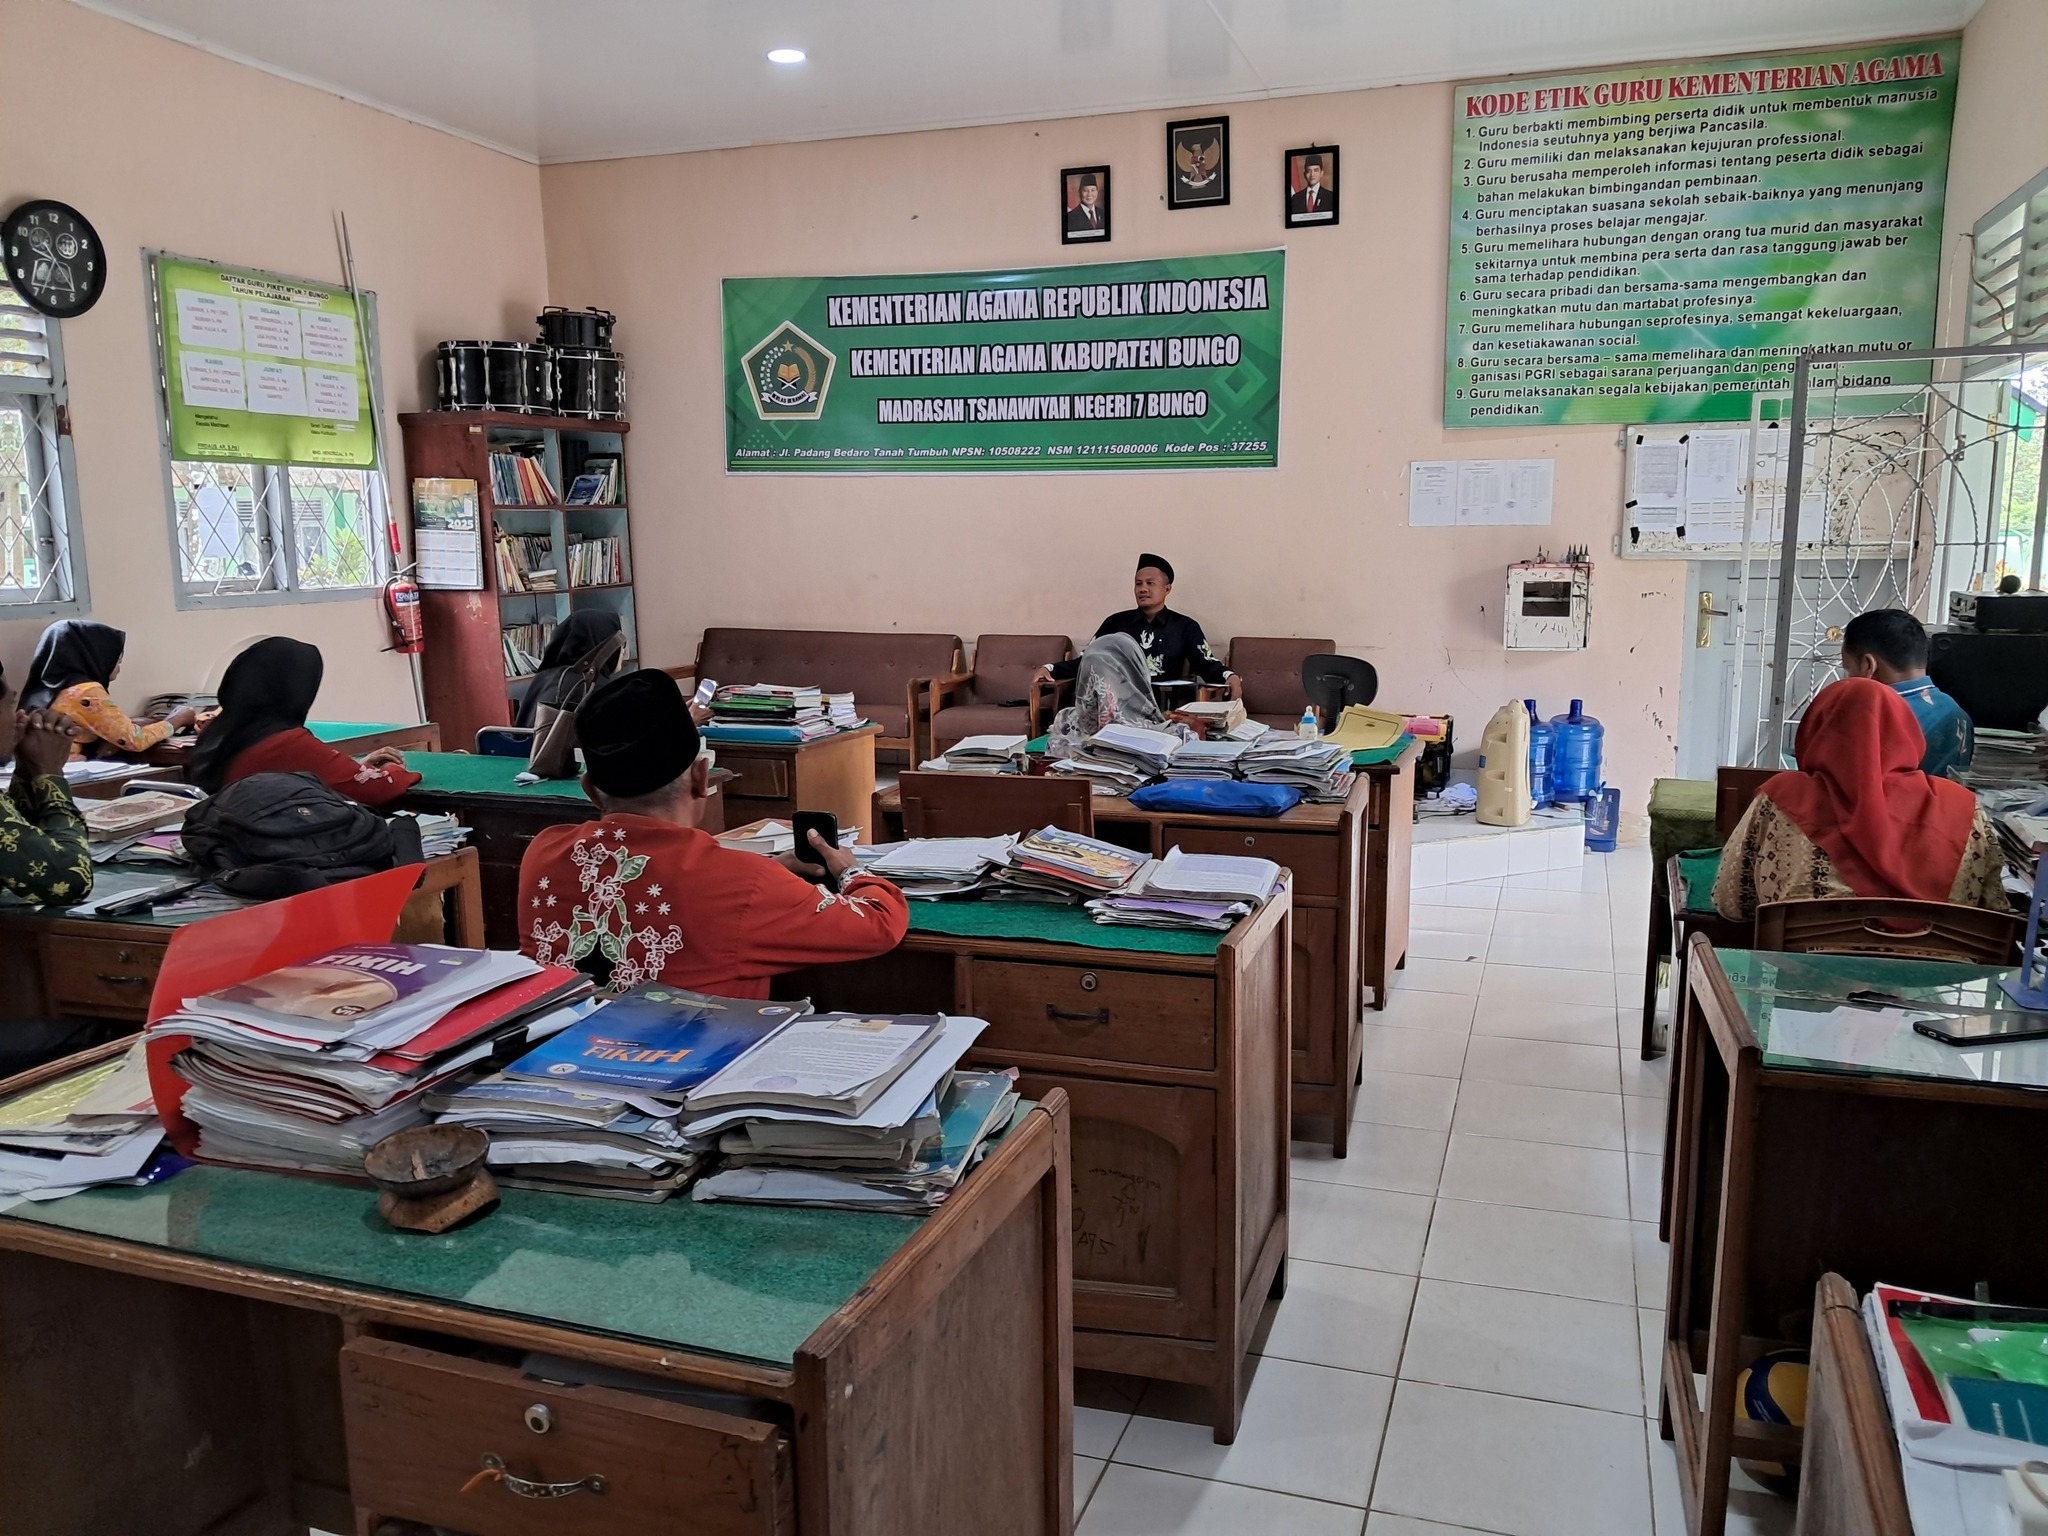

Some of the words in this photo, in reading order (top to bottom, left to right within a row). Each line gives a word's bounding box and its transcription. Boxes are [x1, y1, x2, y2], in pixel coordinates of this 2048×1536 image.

[1465, 92, 1530, 118] KODE
[1534, 86, 1590, 112] ETIK
[1593, 78, 1664, 106] GURU
[1668, 63, 1848, 98] KEMENTERIAN
[1850, 52, 1945, 84] AGAMA
[1466, 128, 1475, 138] 1.
[1478, 126, 1508, 138] Guru
[1513, 120, 1563, 134] berbakti
[1567, 114, 1650, 129] membimbing
[1654, 108, 1708, 124] perserta
[1712, 104, 1745, 117] didik
[1750, 100, 1788, 114] untuk
[1792, 94, 1872, 111] membentuk
[1877, 90, 1938, 104] manusia
[1479, 138, 1538, 152] Indonesia
[1543, 132, 1609, 146] seutuhnya
[1613, 130, 1644, 144] yang
[1649, 125, 1696, 138] berjiwa
[1700, 118, 1768, 133] Pancasila.
[1464, 159, 1474, 170] 2.
[1477, 158, 1507, 169] Guru
[1511, 152, 1562, 166] memiliki
[1567, 150, 1590, 162] dan
[1594, 142, 1686, 159] melaksanakan
[1691, 138, 1752, 154] kejujuran
[1756, 129, 1845, 150] professional.
[1463, 176, 1473, 187] 3.
[1476, 175, 1506, 186] Guru
[1510, 169, 1567, 184] berusaha
[1572, 162, 1650, 179] memperoleh
[1655, 160, 1716, 172] informasi
[1721, 155, 1771, 167] tentang
[1775, 150, 1826, 166] peserta
[1830, 146, 1864, 160] didik
[1868, 144, 1923, 158] sebagai
[1462, 210, 1472, 220] 4.
[1475, 209, 1504, 220] Guru
[1509, 203, 1588, 218] menciptakan
[1592, 200, 1645, 212] suasana
[1650, 194, 1700, 208] sekolah
[1704, 188, 1804, 204] sebaik-baiknya
[1809, 186, 1842, 200] yang
[1846, 181, 1923, 195] menunjang
[29, 214, 40, 225] 11
[48, 213, 59, 224] 12
[69, 223, 74, 232] 1
[17, 226, 28, 237] 10
[1462, 244, 1471, 254] 5.
[1474, 242, 1504, 253] Guru
[1508, 238, 1578, 251] memelihara
[1583, 235, 1646, 247] hubungan
[1651, 231, 1698, 244] dengan
[1703, 228, 1741, 240] orang
[1745, 226, 1766, 237] tua
[1770, 222, 1810, 235] murid
[1814, 221, 1838, 233] dan
[1843, 215, 1923, 232] masyarakat
[11, 247, 19, 257] 9
[81, 239, 88, 249] 2
[1475, 258, 1537, 270] sekitarnya
[1542, 254, 1576, 266] untuk
[1580, 251, 1638, 264] membina
[1642, 250, 1670, 263] pera
[1674, 247, 1706, 259] serta
[1711, 245, 1735, 256] dan
[1740, 245, 1768, 254] rasa
[1772, 241, 1837, 254] tanggung
[1838, 235, 1881, 252] jawab
[1885, 234, 1908, 246] ber
[17, 268, 25, 279] 8
[87, 262, 94, 272] 3
[32, 287, 40, 296] 7
[81, 281, 88, 291] 4
[220, 274, 246, 285] DAFTAR
[247, 279, 265, 288] GURU
[266, 283, 284, 292] PIKET
[308, 291, 329, 300] BUNGO
[231, 286, 254, 296] TAHUN
[254, 290, 291, 302] PELAJARAN
[1460, 290, 1469, 301] 6.
[1473, 290, 1502, 300] Guru
[1506, 289, 1546, 299] secara
[1550, 284, 1592, 299] pribadi
[1597, 284, 1620, 294] dan
[1624, 280, 1718, 293] bersama-sama
[1722, 272, 1837, 289] mengembangkan
[1842, 270, 1866, 282] dan
[50, 295, 57, 305] 6
[69, 293, 76, 302] 5
[829, 293, 961, 326] KEMENTERIAN
[966, 289, 1040, 321] AGAMA
[1043, 284, 1144, 318] REPUBLIK
[1149, 277, 1266, 313] INDONESIA
[1472, 304, 1556, 318] meningkatkan
[1560, 302, 1591, 313] mutu
[1596, 301, 1618, 311] dan
[1623, 298, 1679, 310] martabat
[1683, 295, 1756, 310] profesinya.
[1459, 324, 1468, 334] 7.
[1472, 323, 1500, 334] Guru
[1505, 320, 1574, 332] memelihara
[1579, 318, 1642, 330] hubungan
[1646, 313, 1732, 328] seprofesinya,
[1738, 309, 1802, 323] semangat
[1807, 306, 1902, 319] kekeluargaan,
[852, 347, 975, 376] KEMENTERIAN
[979, 344, 1047, 373] AGAMA
[1051, 340, 1163, 370] KABUPATEN
[1168, 336, 1239, 366] BUNGO
[1458, 358, 1467, 368] 8.
[1470, 357, 1499, 368] Guru
[1504, 357, 1543, 366] secara
[1547, 354, 1599, 364] bersama
[1615, 353, 1647, 362] sama
[1652, 348, 1726, 360] memelihara
[1730, 347, 1754, 358] dan
[1858, 341, 1893, 352] mutu
[1897, 341, 1912, 351] or
[879, 399, 964, 422] MADRASAH
[968, 396, 1070, 421] TSANAWIYAH
[1074, 394, 1131, 418] NEGERI
[1135, 394, 1144, 416] 7
[1148, 392, 1206, 416] BUNGO
[779, 448, 790, 456] Jl.
[794, 448, 831, 459] Padang
[834, 448, 870, 457] Bedaro
[874, 448, 904, 456] Tanah
[908, 448, 948, 456] Tumbuh
[952, 447, 985, 456] NPSN:
[989, 446, 1041, 456] 10508222
[1047, 446, 1073, 455] NSM
[1077, 444, 1158, 454] 121115080006
[1165, 443, 1194, 452] Kode
[1198, 443, 1219, 452] Pos
[1230, 442, 1267, 451] 37255
[447, 518, 474, 529] 2025
[307, 954, 428, 976] FIKIH
[582, 1046, 694, 1063] FIKIH
